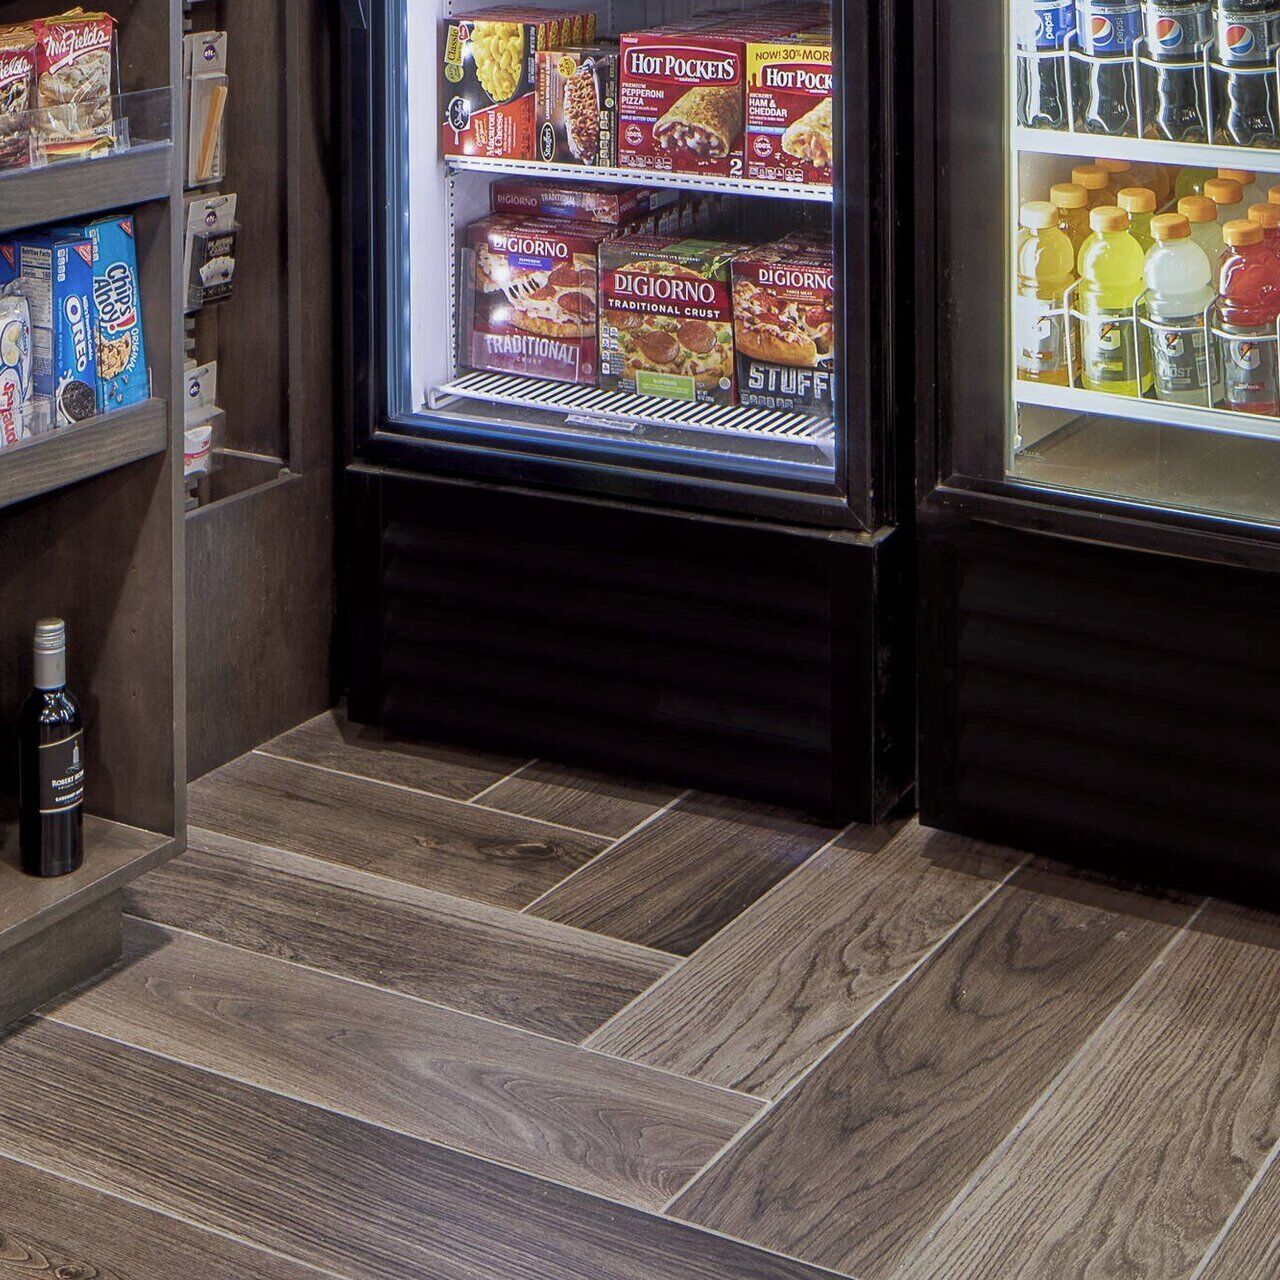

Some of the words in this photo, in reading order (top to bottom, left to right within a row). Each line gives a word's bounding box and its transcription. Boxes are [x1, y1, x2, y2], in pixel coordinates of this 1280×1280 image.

[1043, 12, 1055, 40] pepsi
[755, 50, 782, 61] NOW!
[631, 53, 662, 75] HOT
[664, 54, 736, 81] POCKETS
[766, 68, 796, 88] HOT
[621, 88, 665, 99] PEPPERONI
[621, 96, 644, 106] PIZZA
[749, 98, 769, 109] HAM
[749, 107, 788, 118] CHEDDAR
[729, 158, 743, 175] 2
[608, 299, 681, 315] TRADITIONAL
[684, 307, 720, 319] CRUST
[65, 295, 87, 373] OREO
[484, 333, 576, 365] TRADITIONAL
[748, 362, 833, 401] STUFF
